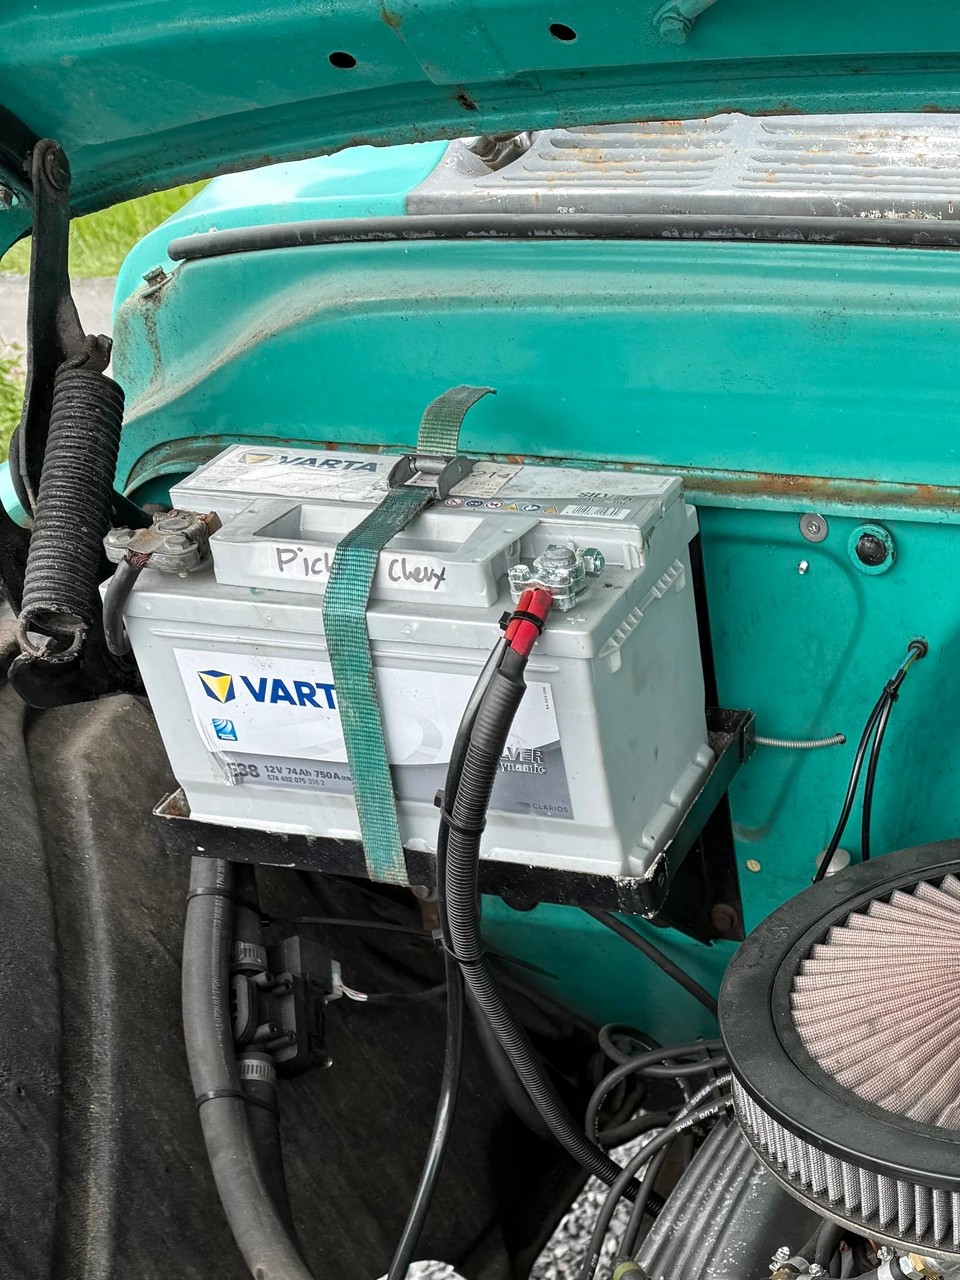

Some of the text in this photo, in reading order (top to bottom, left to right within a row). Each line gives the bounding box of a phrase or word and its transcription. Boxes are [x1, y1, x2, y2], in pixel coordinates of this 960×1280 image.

[280, 455, 379, 473] VARTA
[239, 675, 337, 710] VART
[263, 764, 284, 775] 12V
[532, 802, 569, 814] CLARIOS
[690, 1085, 711, 1106] SUPER
[699, 1105, 719, 1120] PLUG
